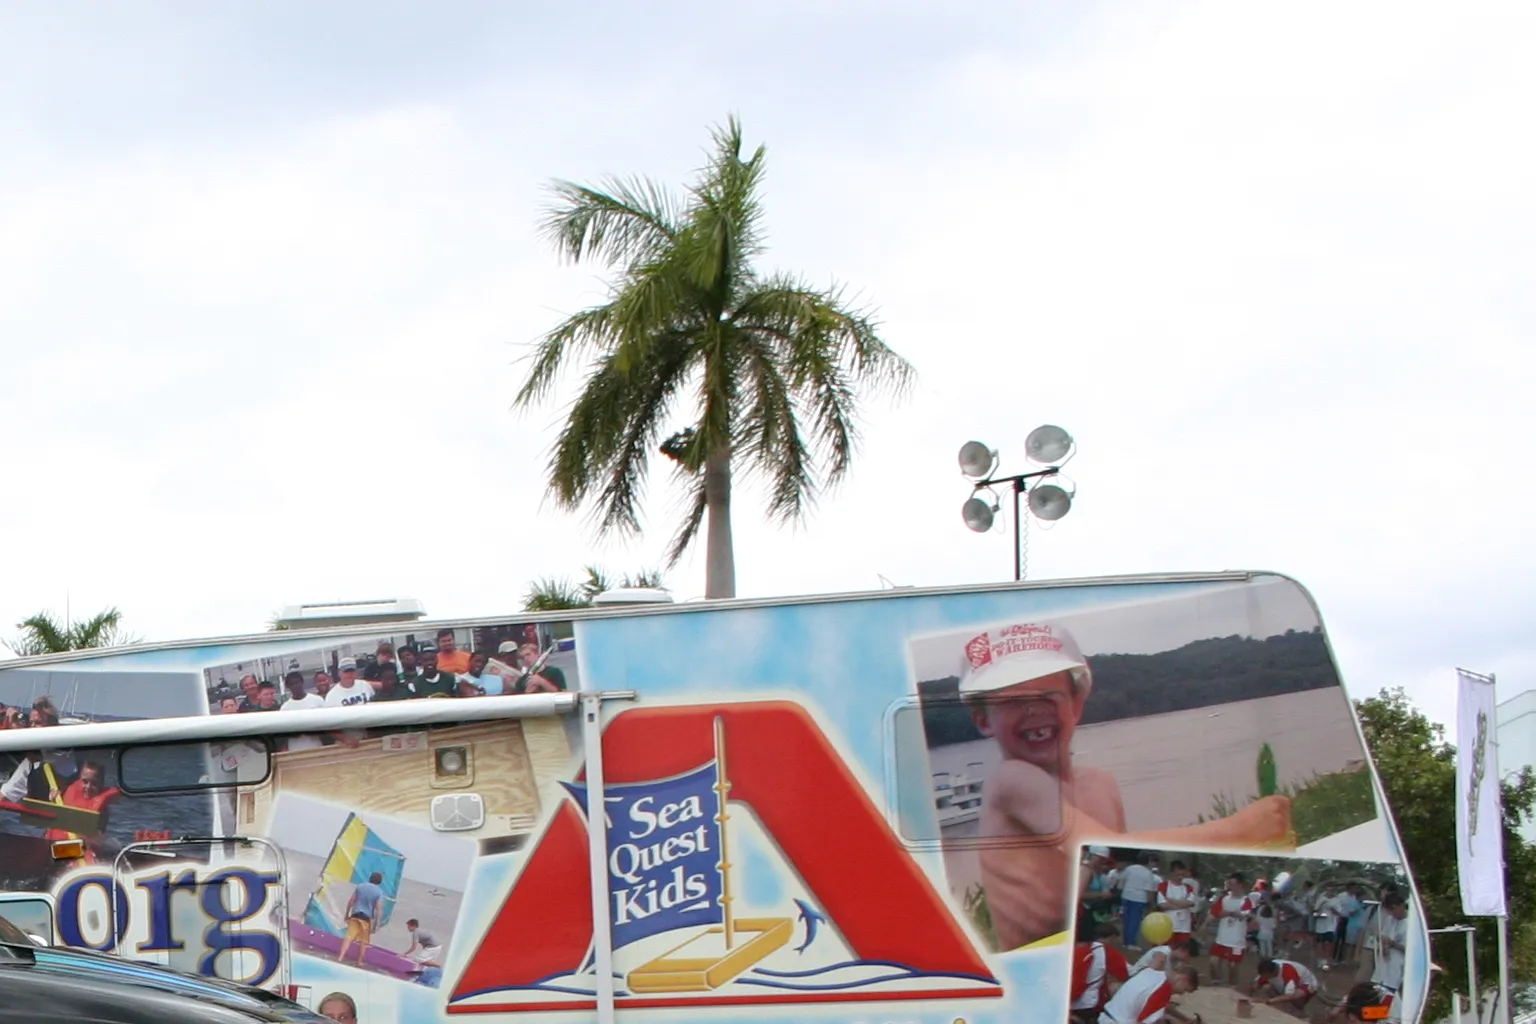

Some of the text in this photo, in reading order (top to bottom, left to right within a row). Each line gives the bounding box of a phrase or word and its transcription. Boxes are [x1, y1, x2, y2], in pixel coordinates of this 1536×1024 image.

[629, 795, 703, 839] Sea
[609, 825, 710, 884] Quest
[613, 865, 708, 925] Kids
